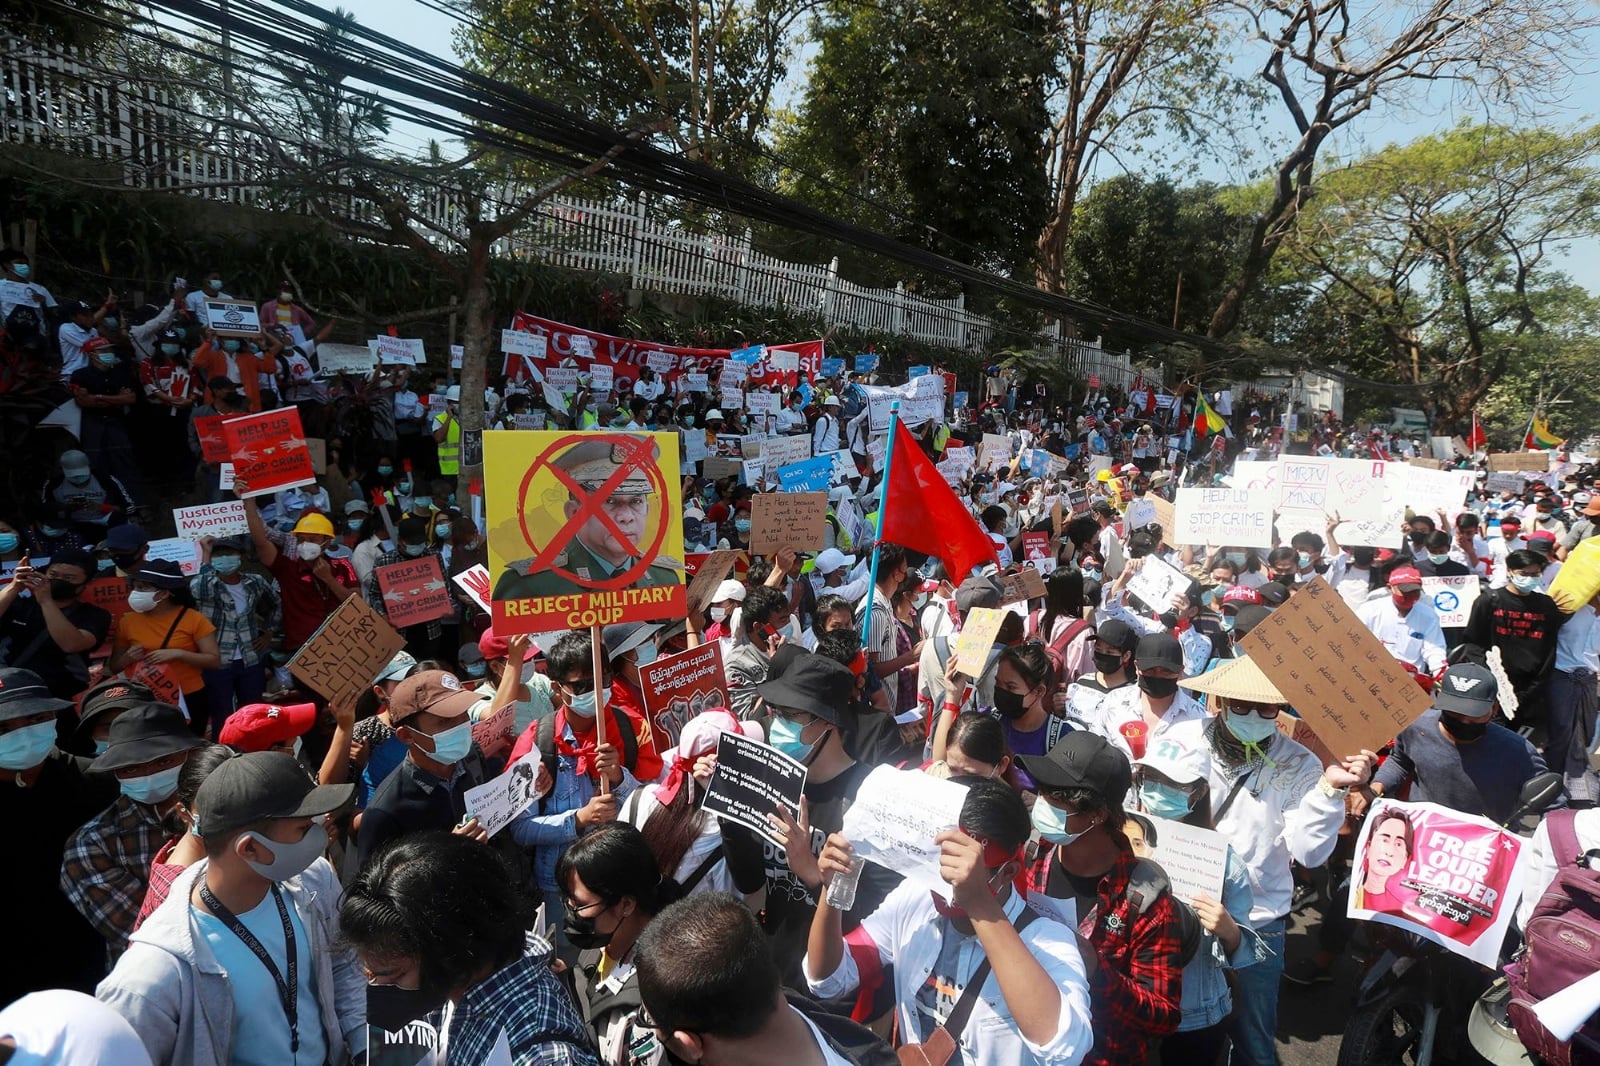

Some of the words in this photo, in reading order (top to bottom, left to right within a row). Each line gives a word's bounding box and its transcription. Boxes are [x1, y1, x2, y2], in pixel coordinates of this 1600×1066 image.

[238, 422, 268, 436] HELP
[272, 418, 289, 429] US
[240, 462, 268, 474] STOP
[270, 454, 306, 468] CRIME
[178, 506, 228, 520] Justice
[182, 514, 245, 529] Myanma
[1190, 512, 1221, 525] STOP
[1222, 512, 1264, 526] CRIME
[386, 567, 414, 580] HELP
[416, 564, 432, 574] US
[1423, 577, 1453, 586] LITARY
[389, 601, 414, 614] STOP
[416, 593, 448, 607] CRIME
[505, 594, 583, 617] REJECT
[589, 586, 675, 609] MILITARY
[566, 607, 624, 628] COUP
[1441, 614, 1464, 624] END
[296, 598, 361, 672] REJECT
[326, 630, 377, 693] COUP
[1316, 666, 1338, 687] please
[1379, 667, 1396, 684] and
[1351, 665, 1367, 684] from
[1377, 696, 1391, 710] and
[722, 735, 736, 745] The
[736, 740, 763, 755] military
[763, 750, 770, 758] is
[794, 767, 802, 778] the
[738, 748, 767, 766] criminals
[768, 761, 780, 772] from
[1157, 742, 1180, 761] 21
[716, 762, 740, 776] Further
[740, 772, 766, 788] violence
[767, 784, 773, 792] is
[773, 788, 781, 797] not
[720, 771, 728, 780] by
[729, 774, 740, 785] us,
[740, 780, 766, 796] peaceful
[470, 796, 482, 805] WE
[472, 804, 486, 814] OUR
[487, 788, 507, 807] LEADER
[710, 790, 732, 804] Please
[734, 800, 750, 812] don't
[727, 806, 740, 816] the
[740, 810, 763, 829] military
[1180, 851, 1192, 859] Aung
[1200, 842, 1224, 852] Myanmar
[1428, 830, 1496, 866] FREE
[1197, 868, 1220, 879] Myanmar
[1428, 851, 1488, 883] OUR
[1180, 878, 1196, 886] Elected
[1408, 860, 1498, 908] LEADER
[232, 922, 267, 958] pushBUTTON
